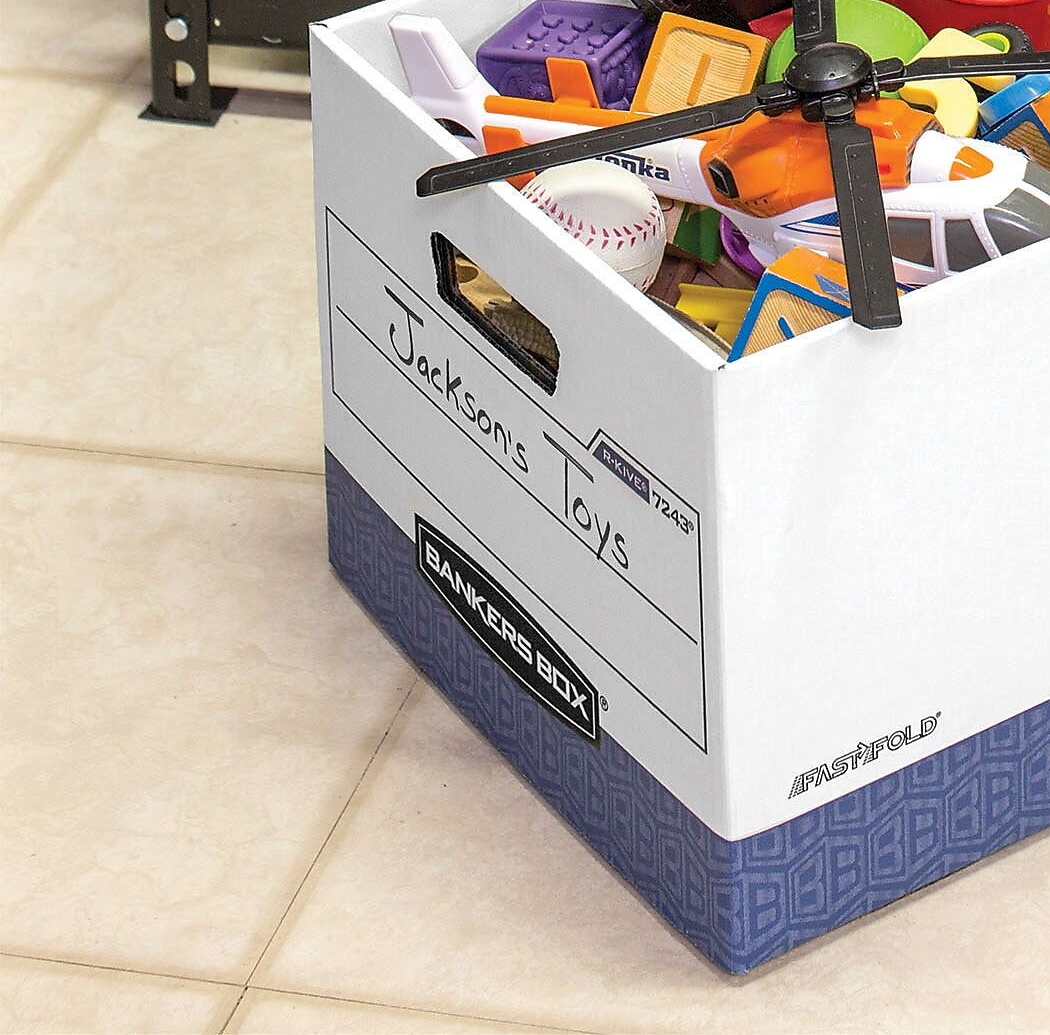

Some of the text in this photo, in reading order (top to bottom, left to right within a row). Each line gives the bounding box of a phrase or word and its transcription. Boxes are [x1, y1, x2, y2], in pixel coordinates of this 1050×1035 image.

[384, 284, 629, 570] Jackson's Toys
[425, 541, 590, 721] BANKERS BOX
